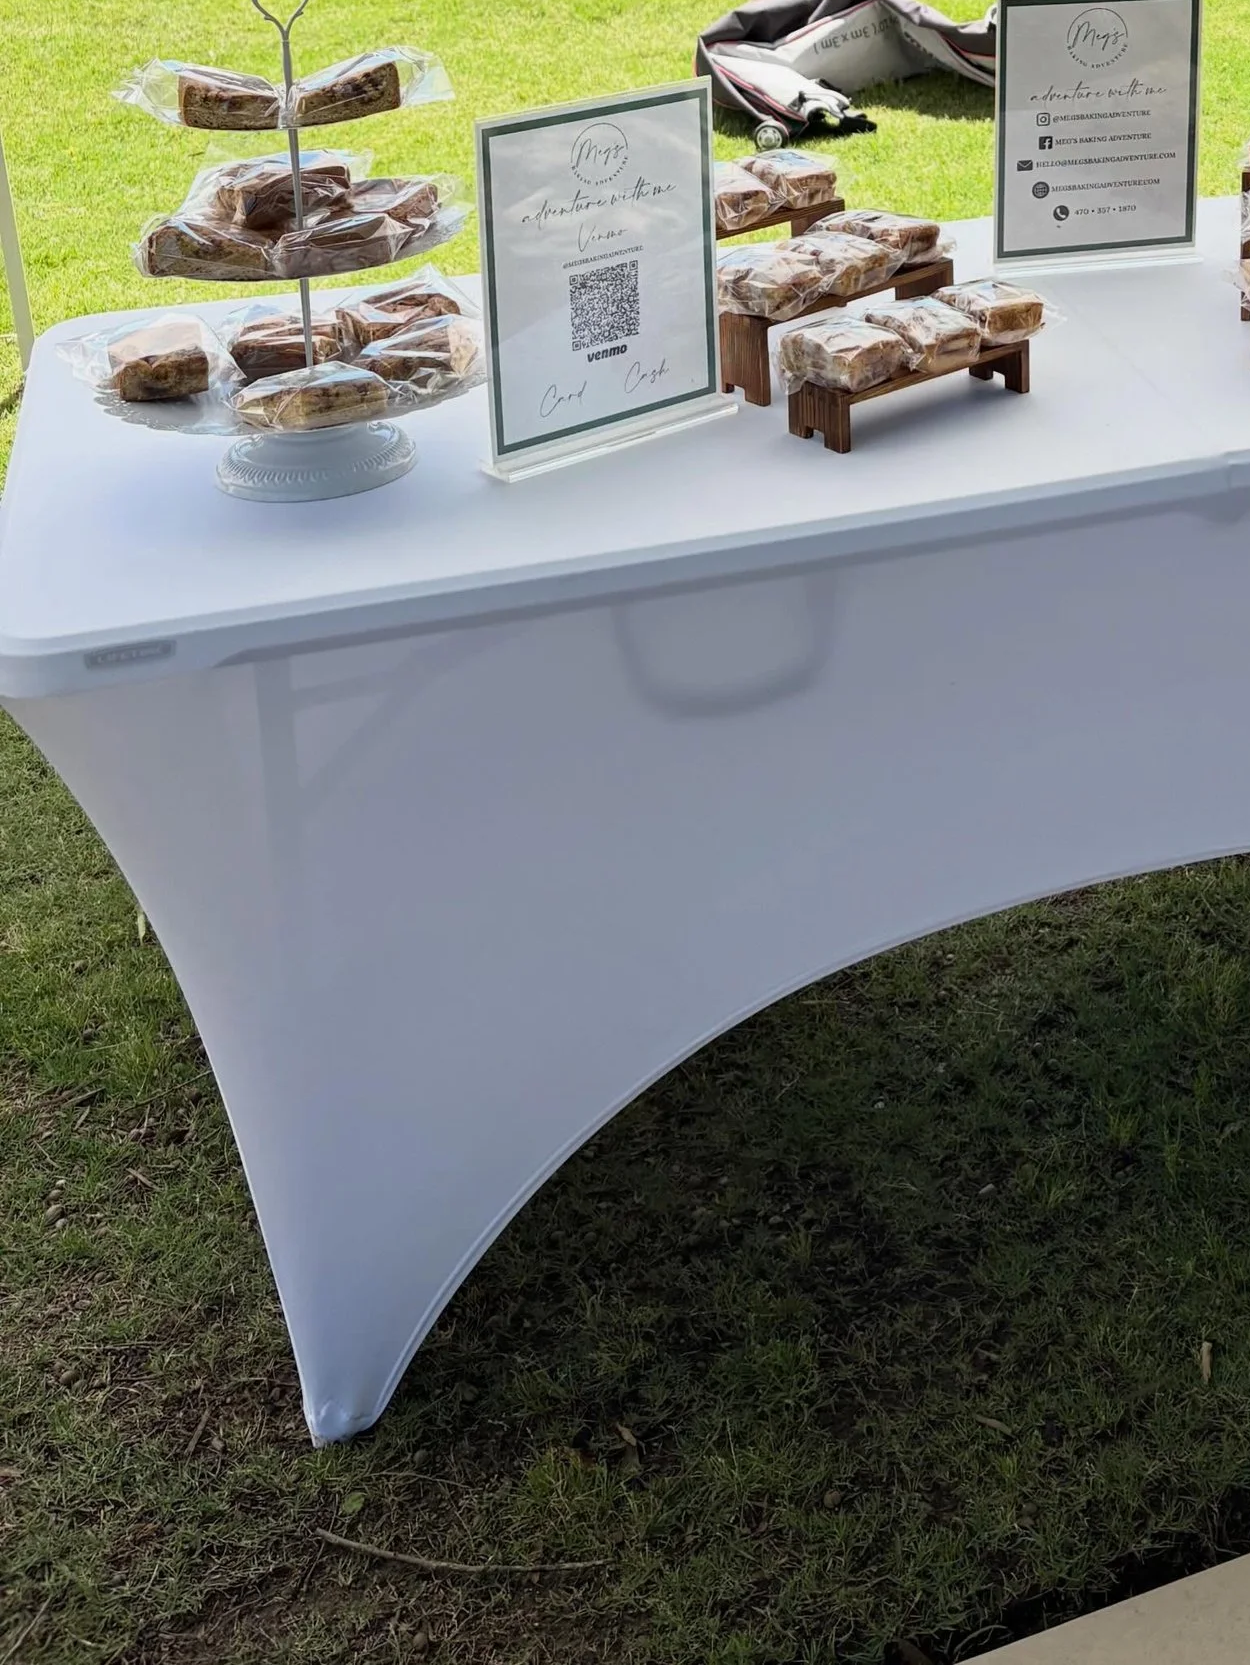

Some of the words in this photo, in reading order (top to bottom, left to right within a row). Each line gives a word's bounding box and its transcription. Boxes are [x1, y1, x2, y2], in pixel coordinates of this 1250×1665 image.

[1072, 21, 1124, 51] Meg's
[1030, 81, 1104, 109] adventure
[1107, 78, 1143, 101] with
[1145, 86, 1167, 96] me
[1055, 137, 1078, 146] MEG'S
[1079, 135, 1107, 144] BAKING
[1108, 133, 1152, 142] ADVENTURE
[521, 189, 607, 230] adventure
[610, 176, 651, 206] with
[652, 183, 677, 196] me
[577, 222, 628, 252] Venmo
[587, 344, 628, 363] venmo
[540, 380, 587, 417] Card
[624, 358, 670, 393] Cash
